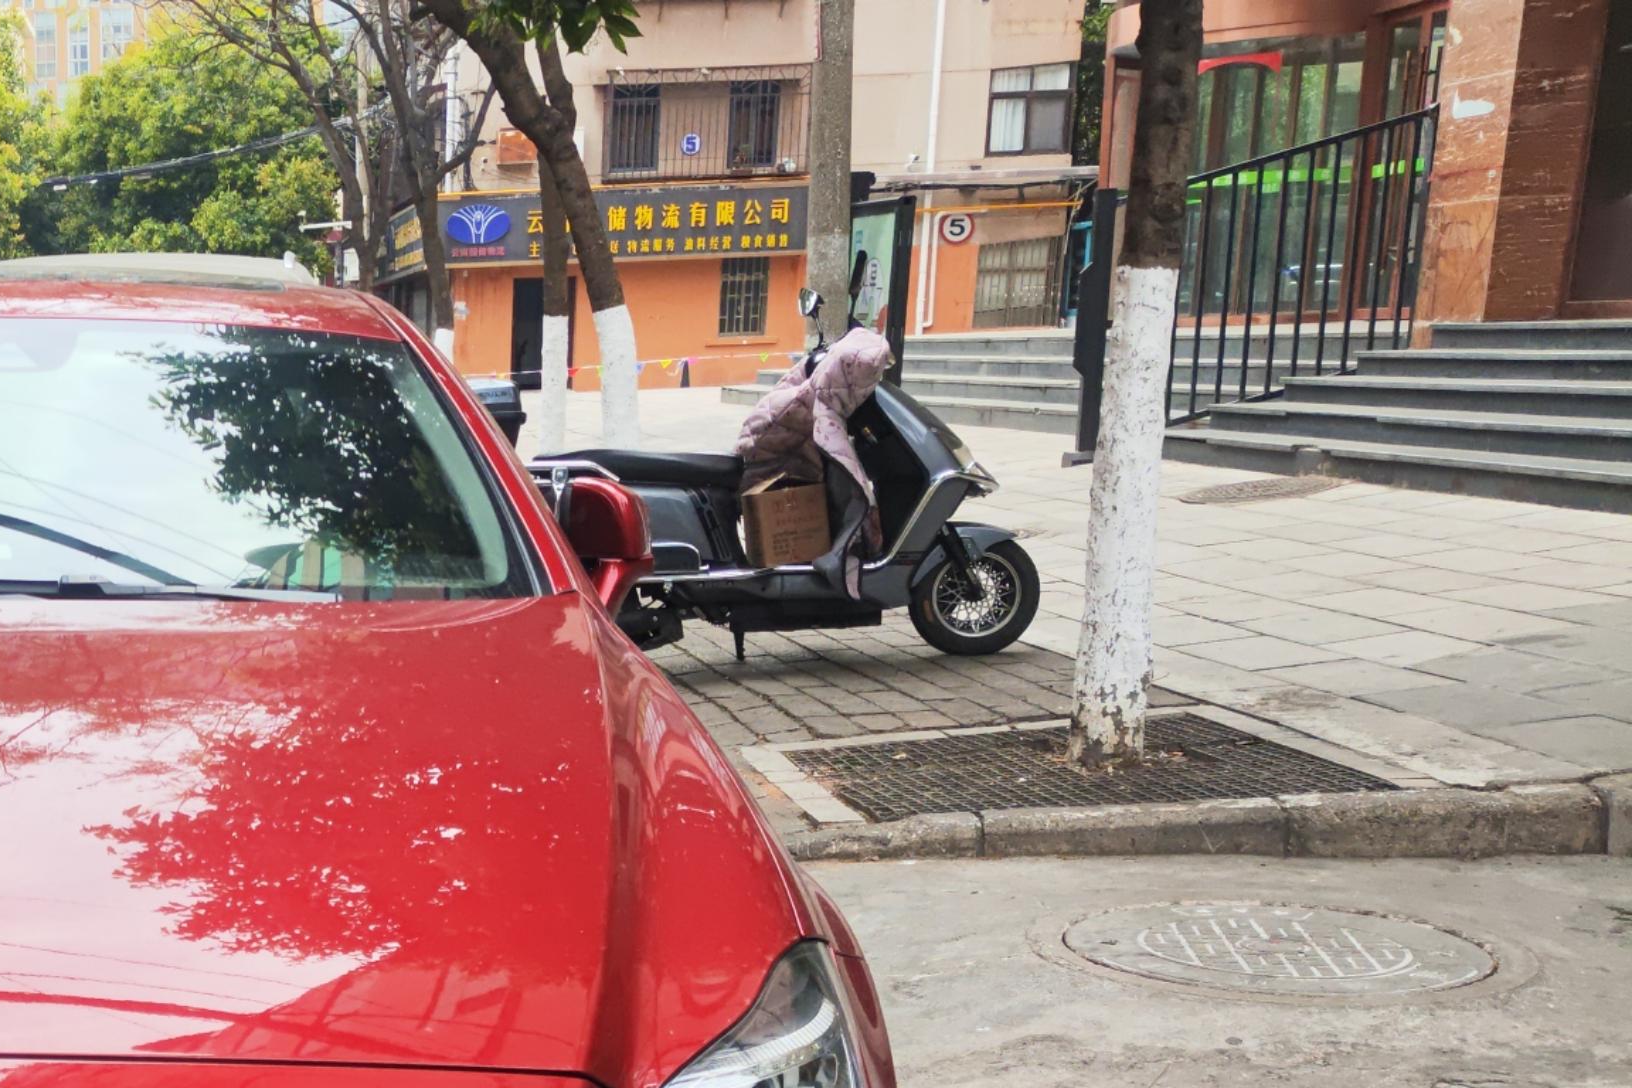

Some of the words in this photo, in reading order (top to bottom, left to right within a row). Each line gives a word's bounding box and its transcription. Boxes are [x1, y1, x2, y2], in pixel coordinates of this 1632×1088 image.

[685, 135, 697, 153] 5
[527, 197, 790, 234] 云储物流有限公司
[948, 218, 966, 236] 5
